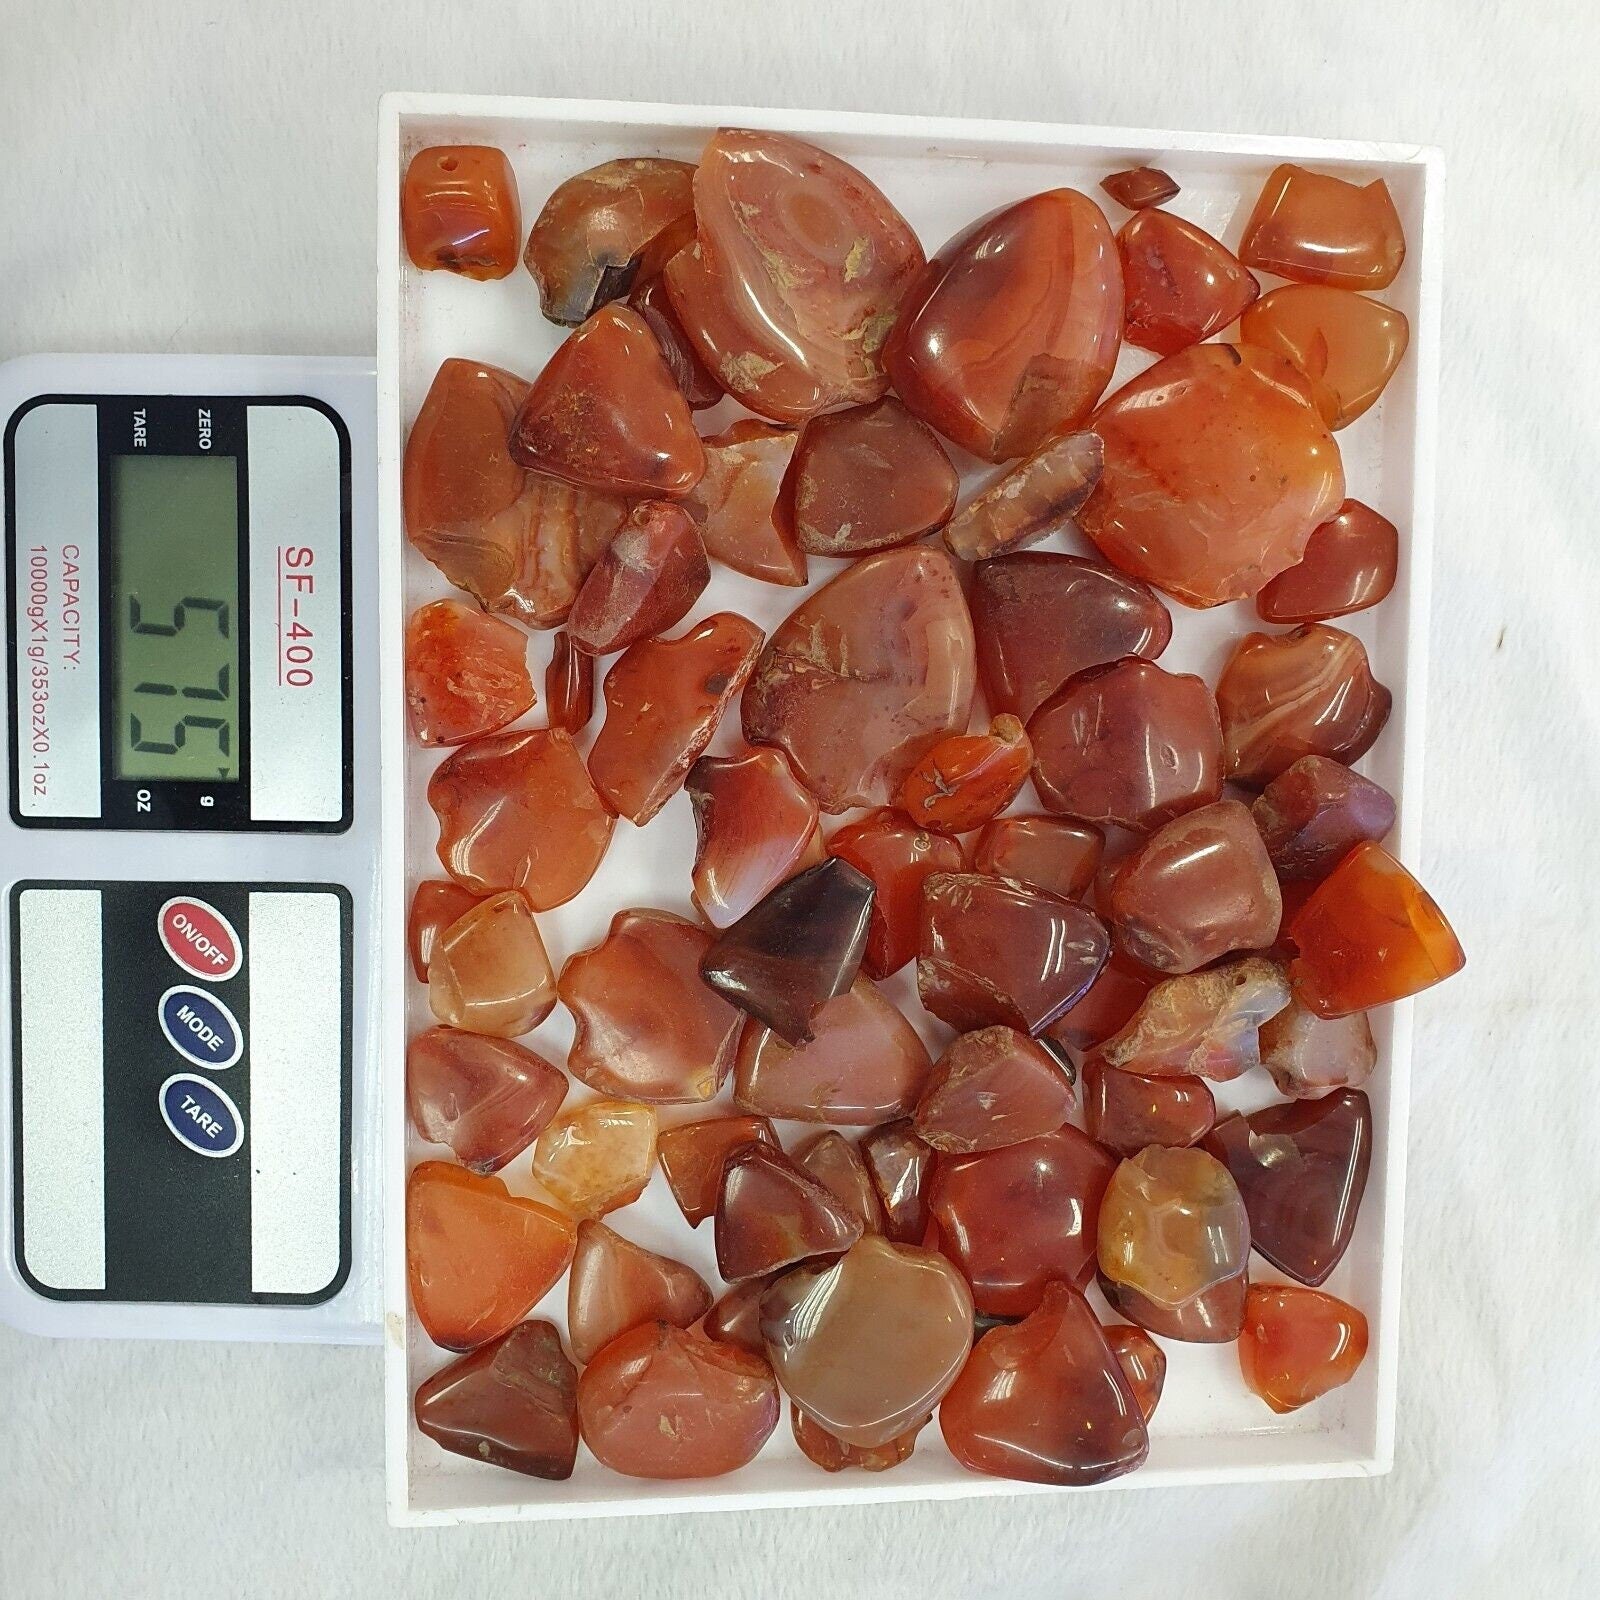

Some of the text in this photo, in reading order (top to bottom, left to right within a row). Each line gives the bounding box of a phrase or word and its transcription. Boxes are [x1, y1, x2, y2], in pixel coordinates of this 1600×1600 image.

[133, 408, 147, 448] TARE
[198, 408, 212, 450] ZERO
[62, 544, 80, 671] CAPACITY:
[285, 546, 314, 687] SF-400
[130, 595, 230, 757] 575
[200, 795, 214, 807] g
[172, 913, 229, 966] ON/OFF
[176, 1005, 224, 1052] MODE
[180, 1095, 223, 1139] TARE
